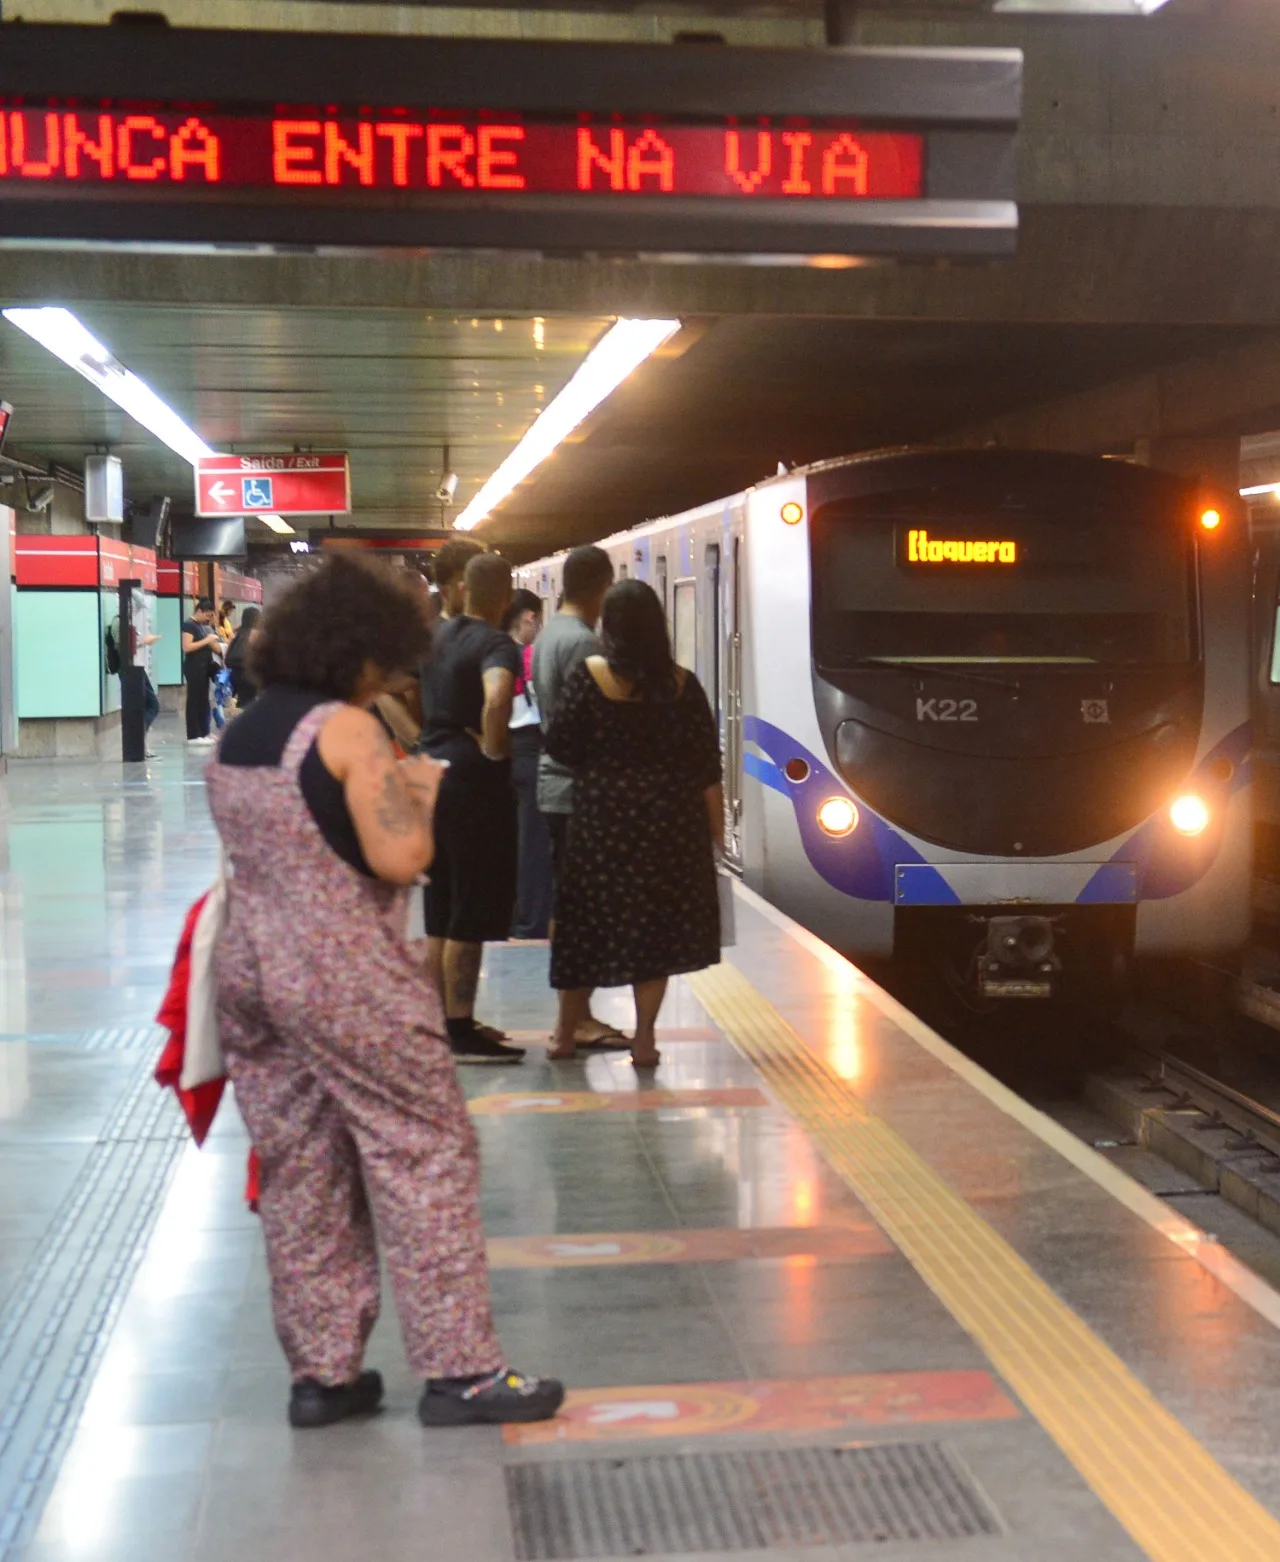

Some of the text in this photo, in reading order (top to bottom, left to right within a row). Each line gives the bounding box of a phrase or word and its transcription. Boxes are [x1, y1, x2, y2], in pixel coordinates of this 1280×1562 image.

[0, 111, 869, 195] UNCA ENTRE NA VIA
[296, 456, 320, 468] Exit
[908, 530, 1015, 563] Itaquera
[916, 698, 978, 721] K22
